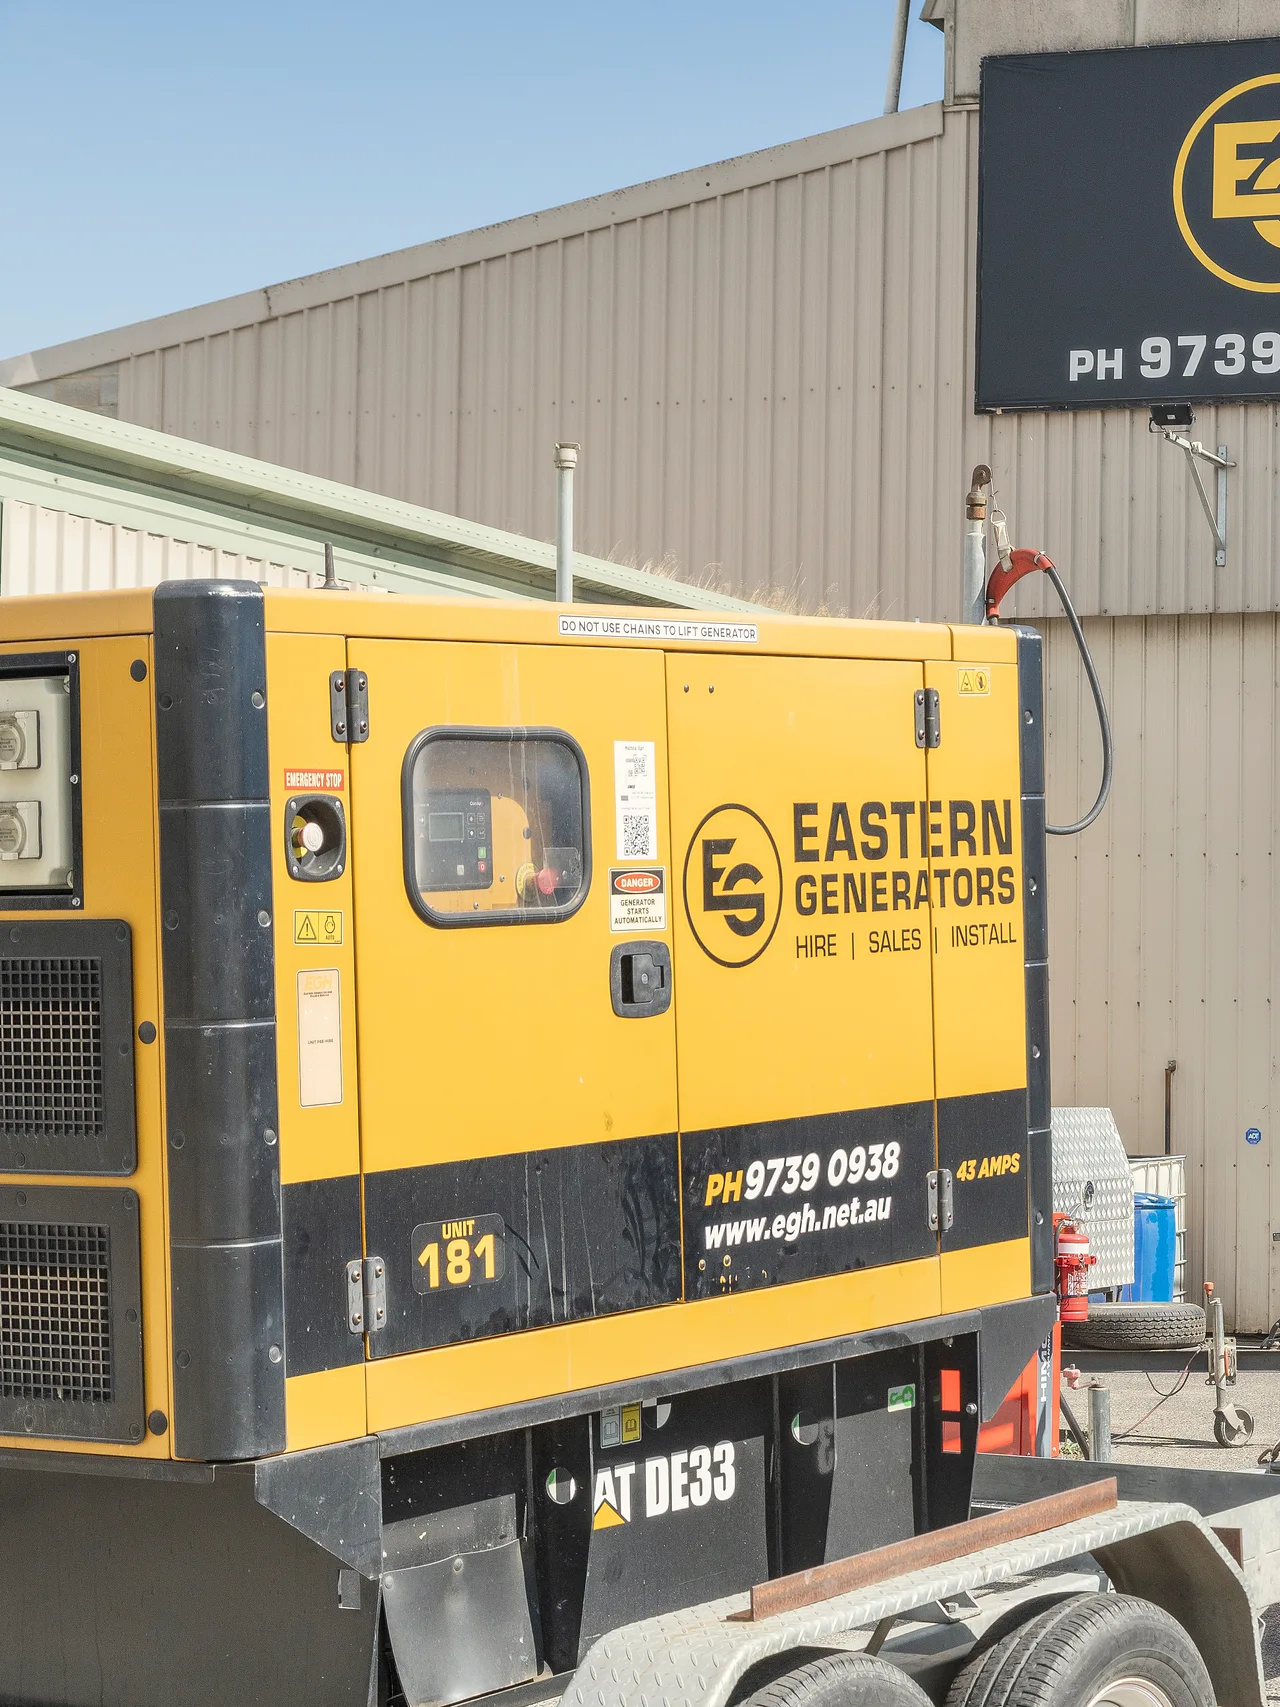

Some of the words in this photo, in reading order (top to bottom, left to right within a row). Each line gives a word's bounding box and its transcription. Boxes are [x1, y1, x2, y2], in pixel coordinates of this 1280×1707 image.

[1069, 348, 1123, 382] PH
[561, 620, 576, 631] DO
[578, 621, 599, 632] NOT
[602, 622, 621, 633] USE
[623, 623, 661, 635] CHAINS
[663, 625, 676, 635] TO
[678, 626, 698, 637] LIFT
[700, 627, 756, 639] GENERATOR
[286, 772, 325, 787] EMERGENCY
[326, 772, 342, 788] STOP
[793, 799, 1013, 863] EASTERN
[621, 877, 654, 888] DANGER
[795, 866, 1015, 916] GENERATORS
[620, 898, 656, 906] GENERATOR
[627, 907, 650, 915] STARTS
[614, 915, 662, 924] AUTOMATICALLY
[796, 934, 837, 958] HIRE
[869, 928, 922, 953] SALES
[951, 922, 1017, 947] INSTALL
[704, 1170, 744, 1206] PH
[744, 1152, 820, 1200] 9739
[827, 1141, 901, 1188] 0938
[956, 1159, 976, 1182] 43
[978, 1152, 1021, 1180] AMPS
[441, 1220, 475, 1239] UNIT
[705, 1196, 893, 1250] www.egh.net.au
[418, 1234, 495, 1288] 181
[593, 1461, 636, 1523] AT
[645, 1440, 736, 1518] DE33
